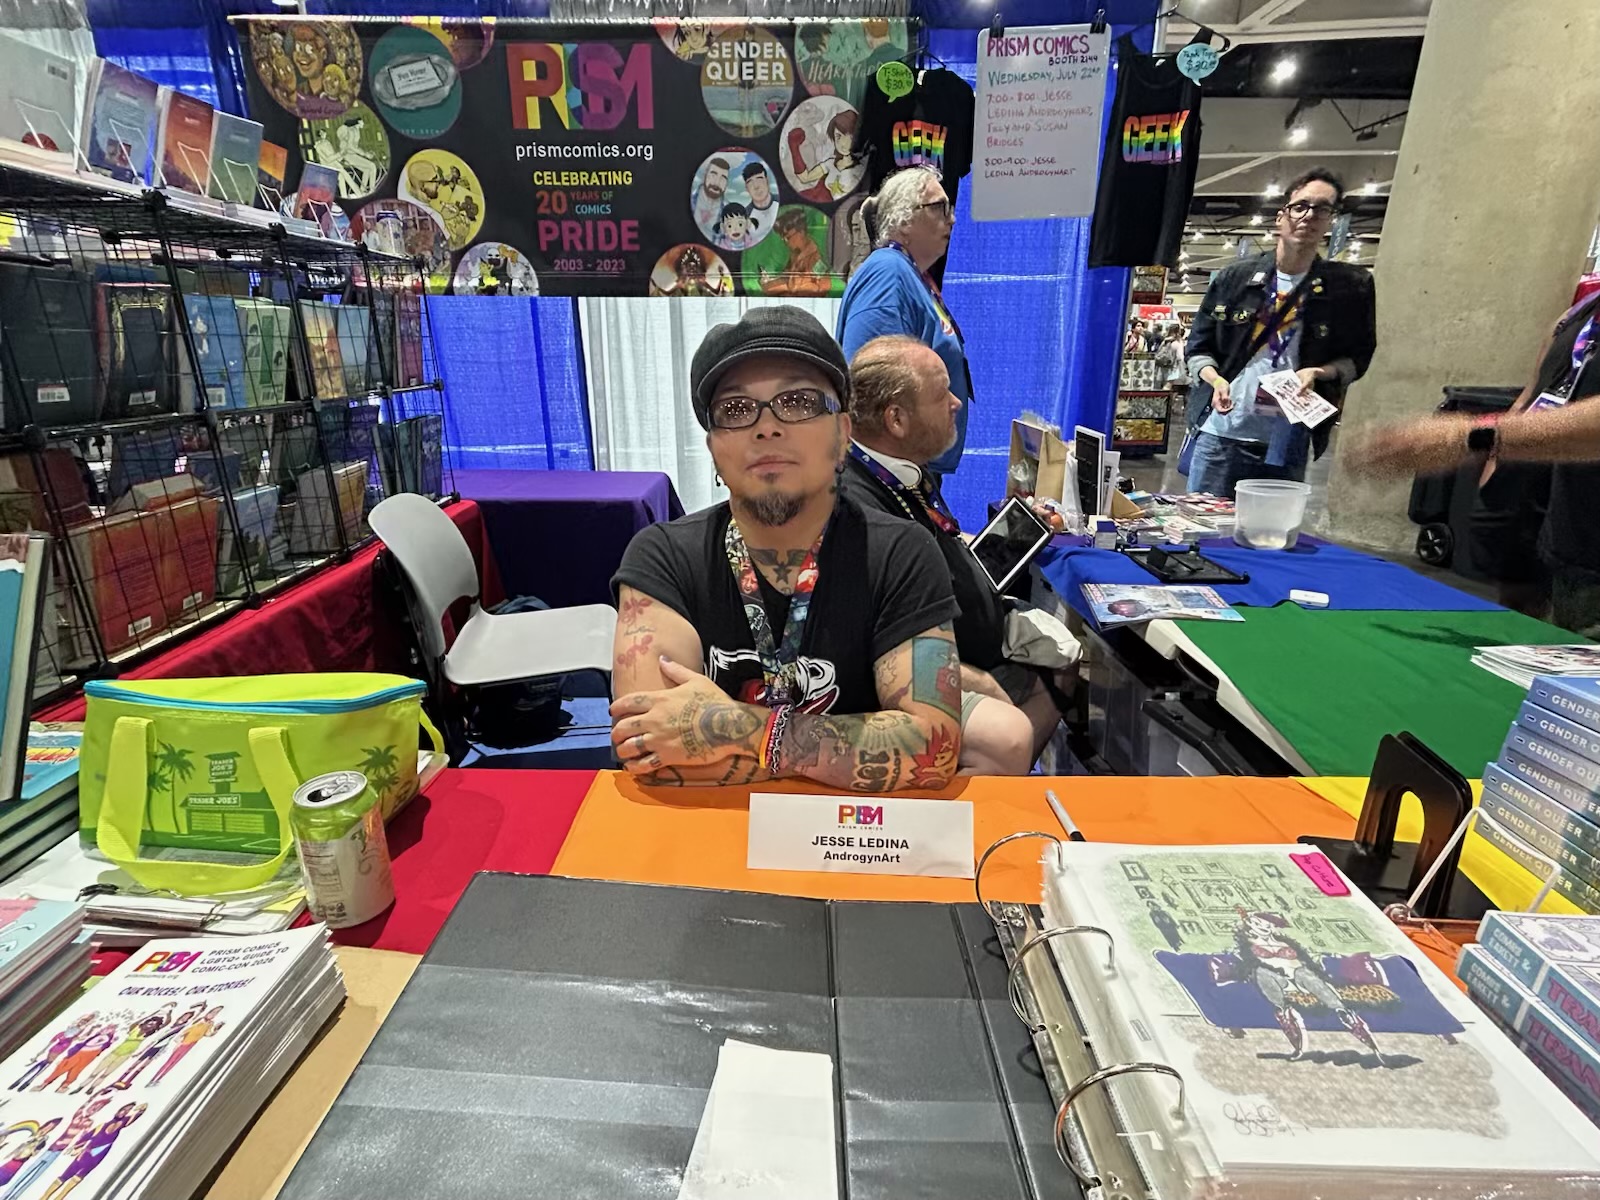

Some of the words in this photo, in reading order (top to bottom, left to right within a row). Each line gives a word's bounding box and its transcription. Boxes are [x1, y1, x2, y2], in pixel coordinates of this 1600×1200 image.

[707, 41, 787, 59] GENDER
[986, 36, 1029, 57] PRISM
[1033, 35, 1090, 56] COMICS
[1049, 55, 1078, 66] BOOTH
[706, 61, 787, 81] QUEER
[1056, 69, 1077, 80] JULY
[892, 120, 947, 168] GEEK
[1122, 110, 1190, 165] GEEK
[515, 142, 655, 161] prismcomics.org
[1031, 156, 1057, 165] JESSE
[533, 171, 633, 186] CELEBRATING
[985, 169, 1014, 178] LEDINA
[536, 190, 568, 215] 20
[570, 191, 600, 200] YEARS
[601, 191, 614, 200] OF
[575, 204, 612, 215] COMICS
[538, 220, 640, 251] PRIDE
[553, 259, 583, 271] 2003
[596, 259, 626, 271] 2023
[1552, 695, 1600, 722] GENDER
[1540, 720, 1588, 748] GENDER
[1528, 742, 1574, 770] GENDER
[1518, 763, 1561, 792] GENDER
[1501, 782, 1541, 813] GENDER
[1544, 809, 1582, 838] QUEER
[811, 835, 855, 847] JESSE
[859, 837, 909, 849] LEDINA
[1498, 808, 1537, 837] GENDER
[1540, 835, 1577, 865] QUEER
[823, 850, 901, 863] AndrogynArt
[1535, 861, 1573, 892] QUER
[200, 956, 240, 964] LGBTQ+
[242, 950, 274, 961] GUIDE
[208, 948, 241, 956] PRISM
[242, 941, 281, 954] COMICS
[191, 961, 249, 973] COMIC-CON
[118, 986, 143, 996] OUR
[185, 986, 206, 996] OUR
